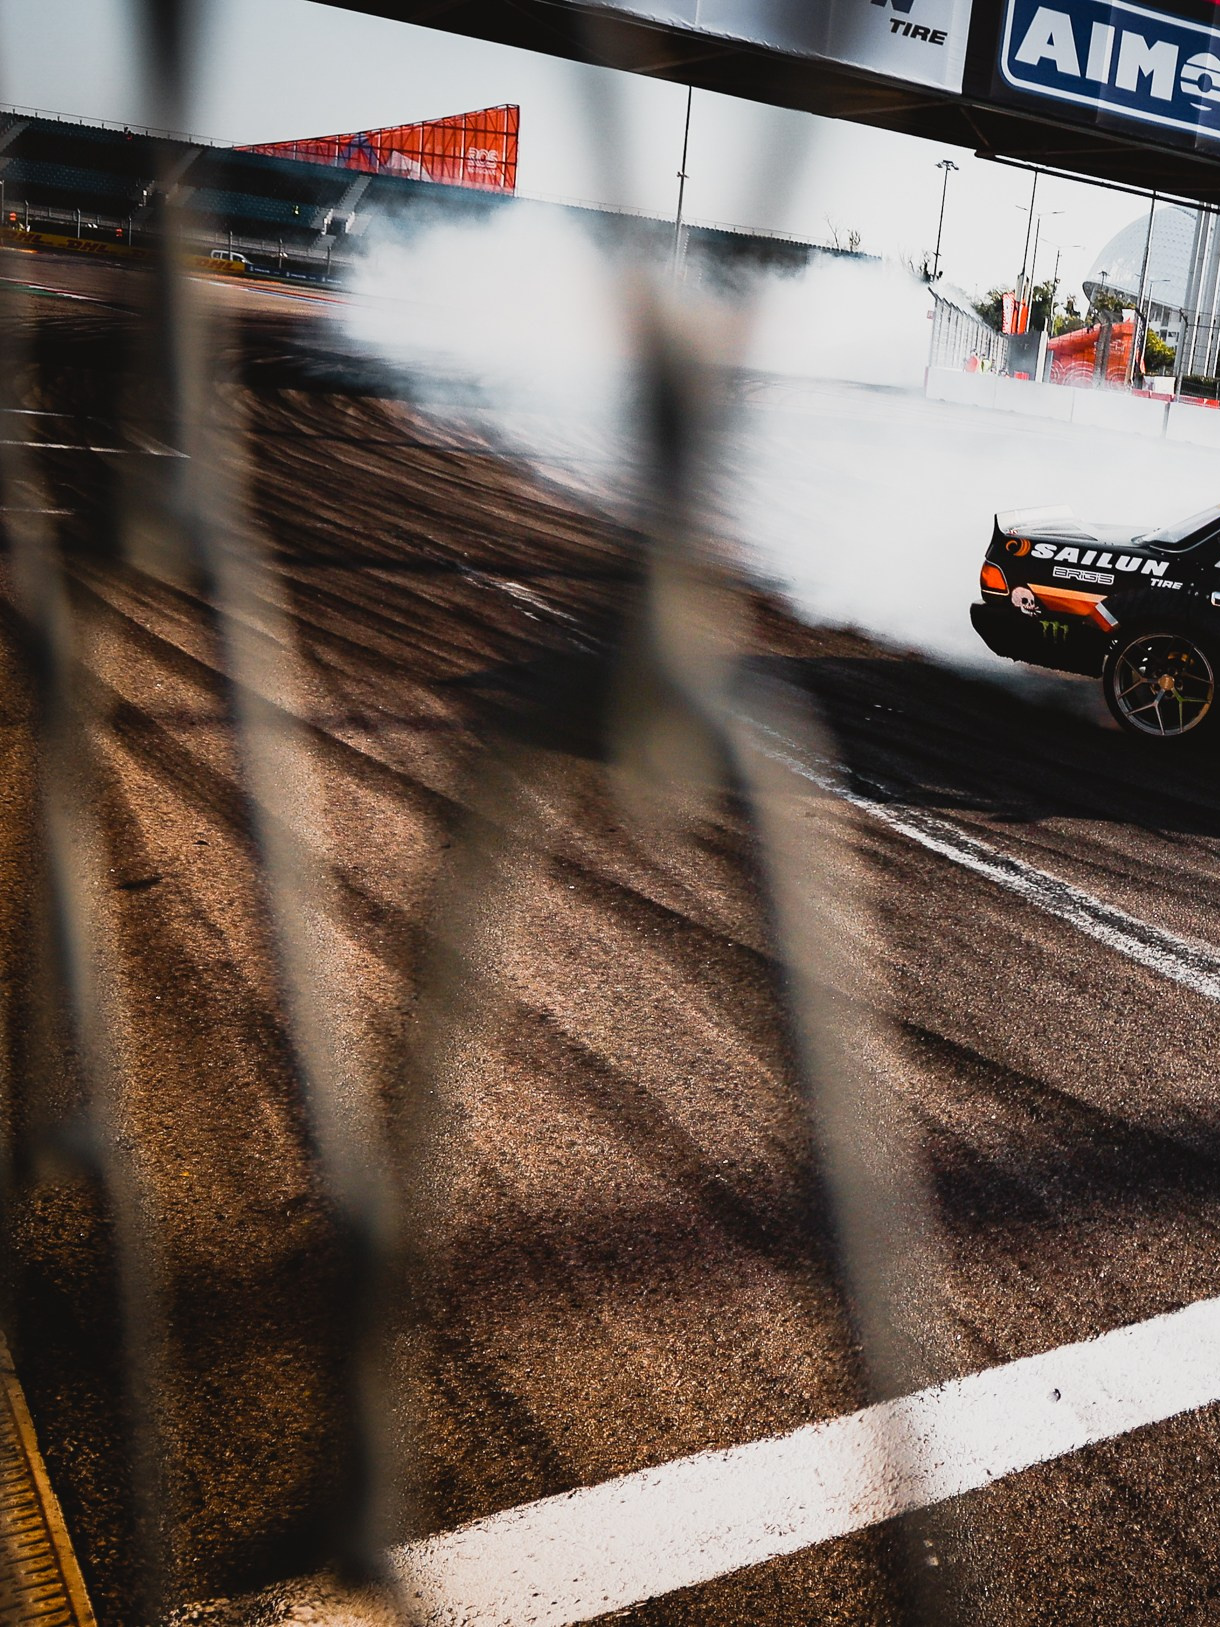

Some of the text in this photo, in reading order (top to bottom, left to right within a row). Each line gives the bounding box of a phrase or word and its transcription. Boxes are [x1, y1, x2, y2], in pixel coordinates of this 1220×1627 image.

[889, 17, 948, 46] TIRE
[1031, 543, 1170, 577] SAILUN
[1150, 577, 1184, 590] TIRE
